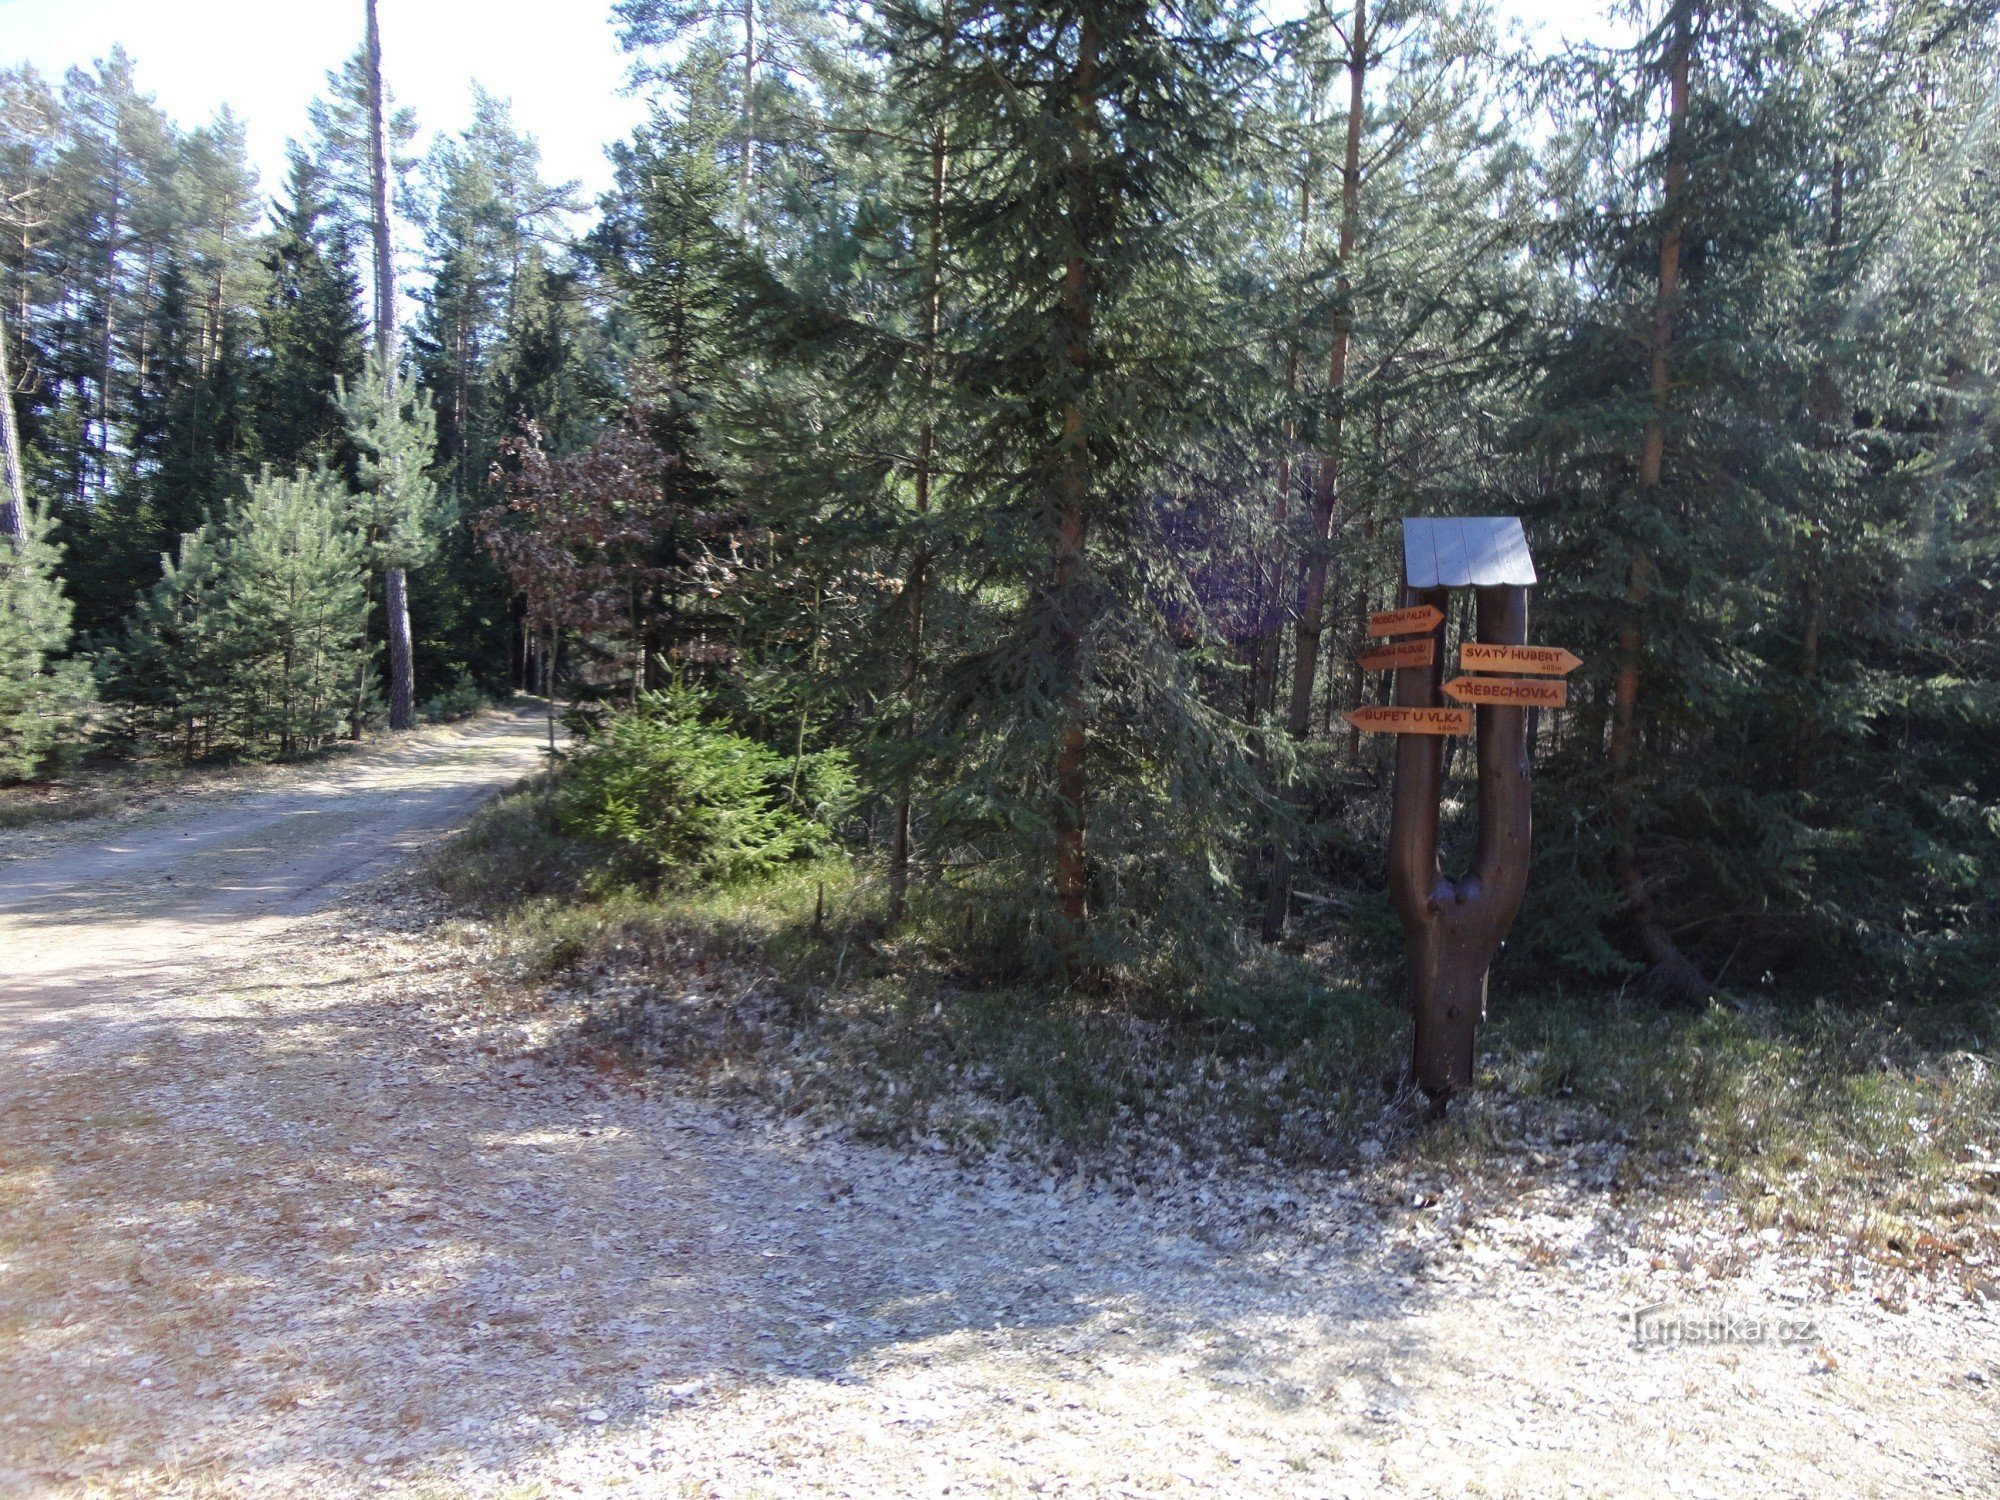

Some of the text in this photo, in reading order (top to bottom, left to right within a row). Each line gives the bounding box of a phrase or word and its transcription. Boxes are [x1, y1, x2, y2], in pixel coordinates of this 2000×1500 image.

[1371, 614, 1405, 626] PRODEJNA
[1406, 609, 1431, 620] PALIVA
[1465, 646, 1562, 662] SVATÝ HUBERT
[1456, 681, 1558, 699] TŘEBECHOVKA
[1365, 710, 1462, 723] BUFET U VLKA
